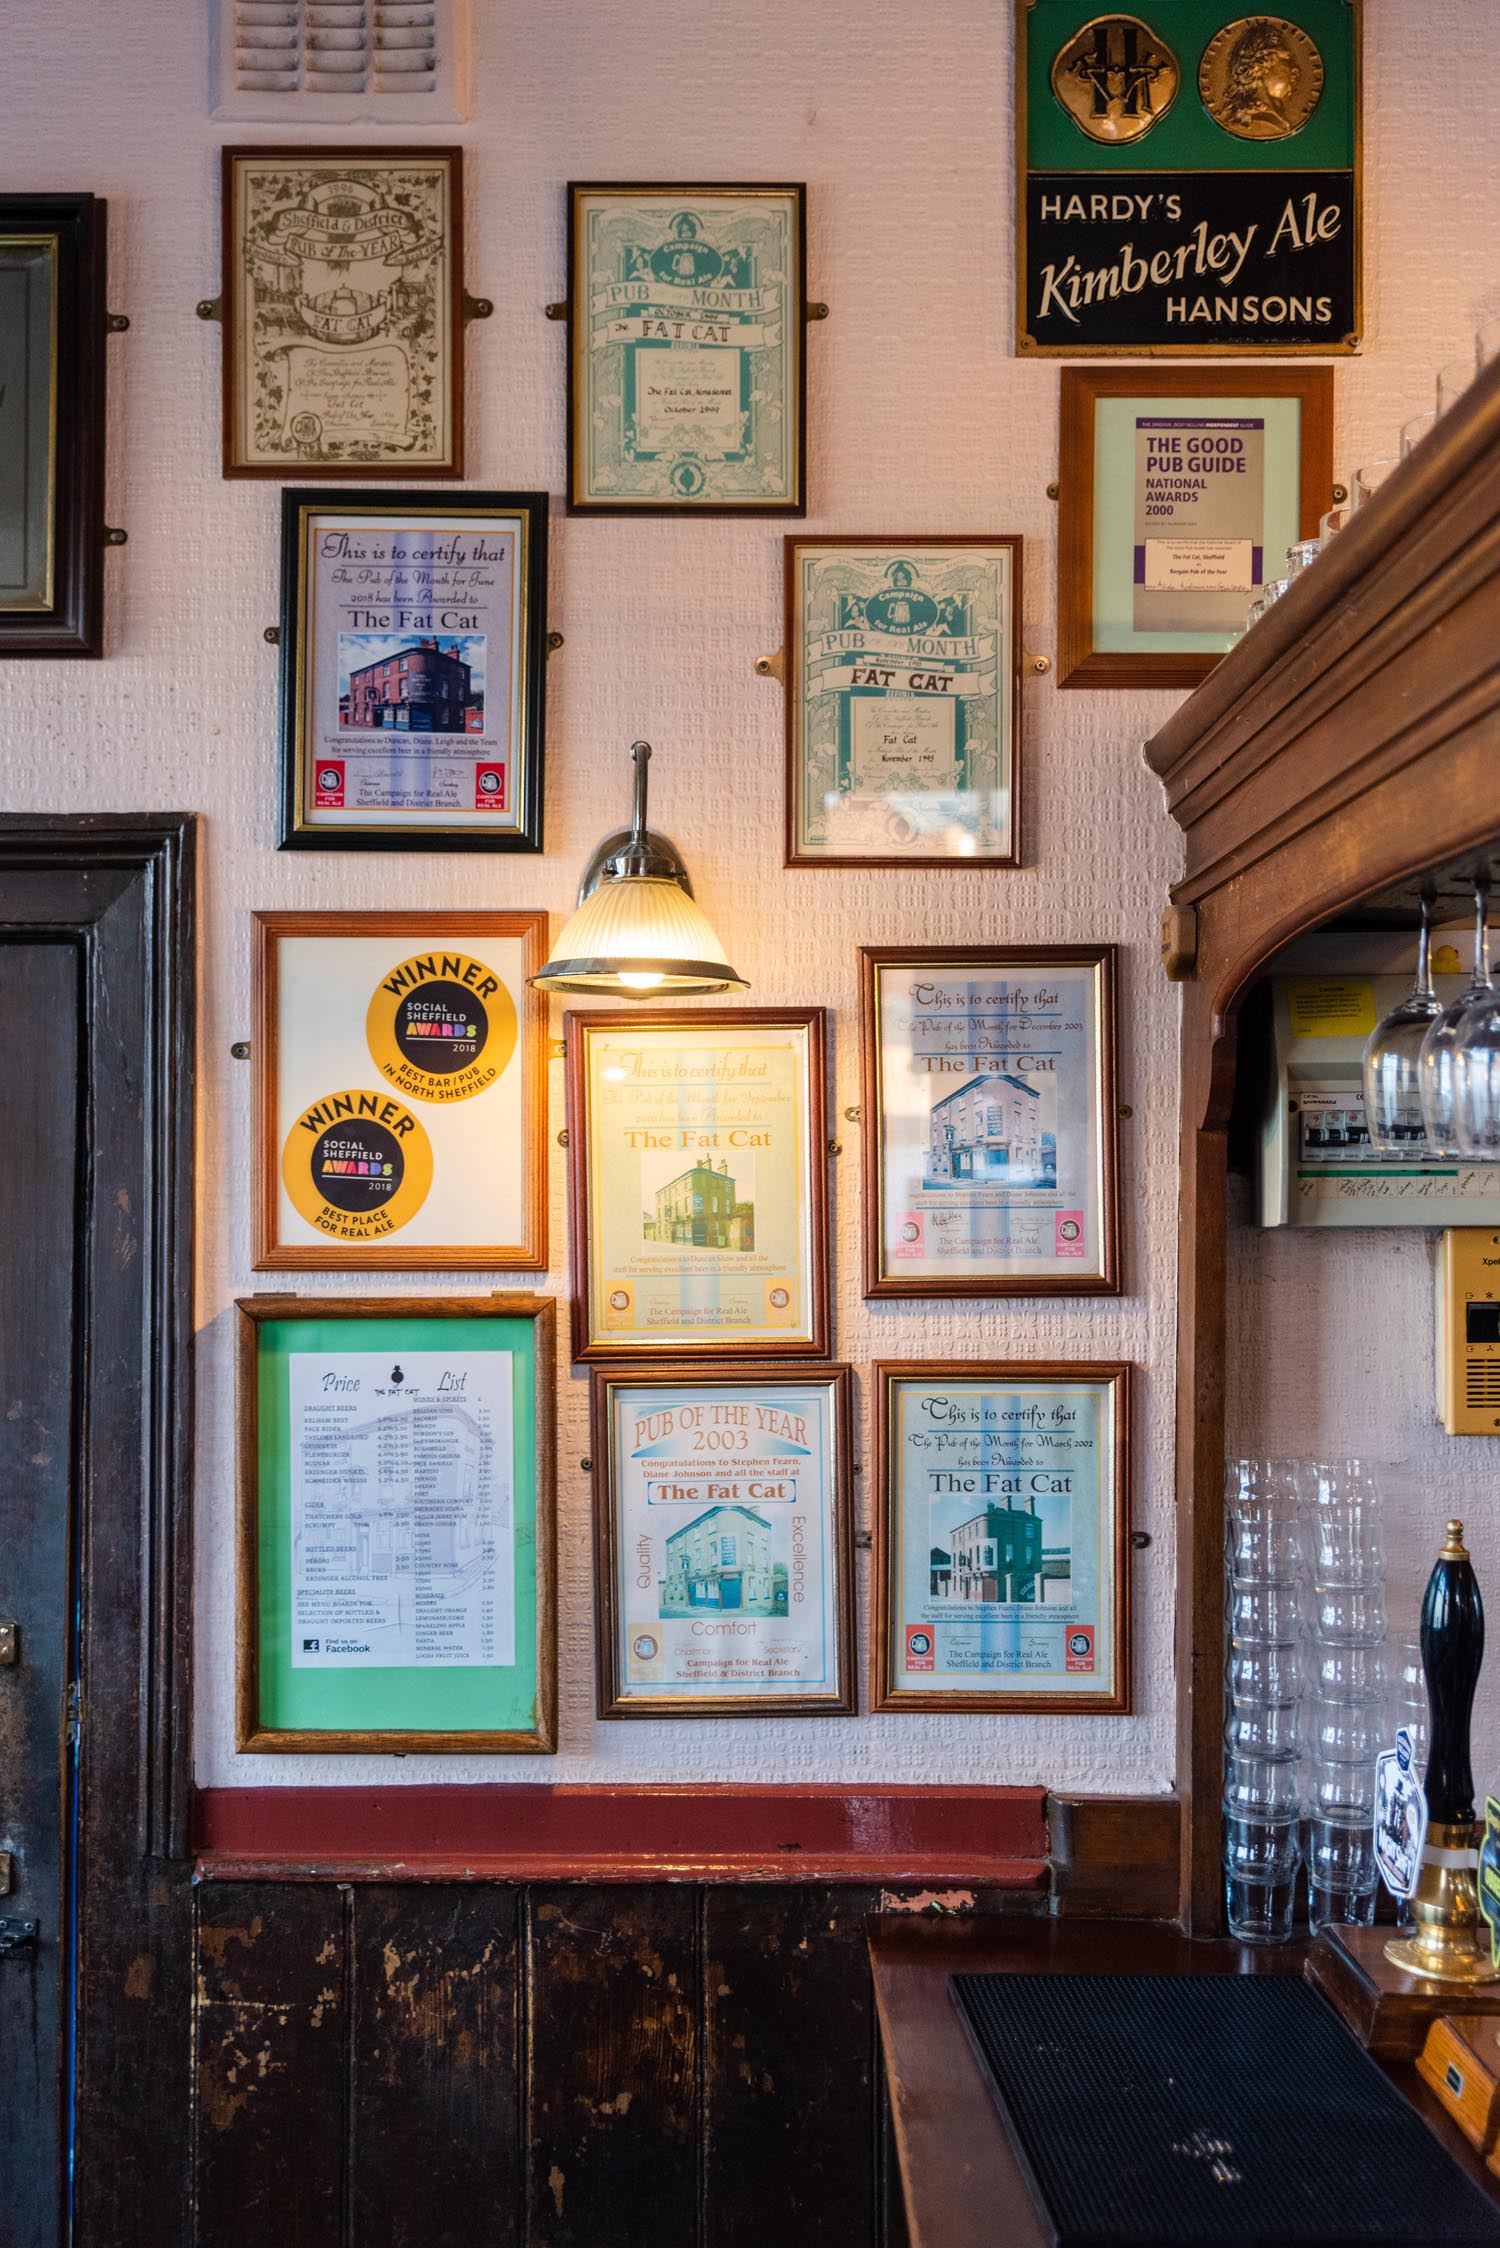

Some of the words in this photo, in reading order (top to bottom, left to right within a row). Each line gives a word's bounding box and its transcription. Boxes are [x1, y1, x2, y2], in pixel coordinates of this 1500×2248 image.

[1040, 194, 1182, 220] HARDY'S
[284, 213, 338, 230] Sheffield
[355, 214, 403, 229] District
[291, 237, 316, 252] PUB
[360, 236, 398, 257] YEAR
[1036, 221, 1258, 324] Kimberley
[1266, 192, 1342, 255] Ale
[610, 286, 649, 301] PUB
[692, 290, 760, 308] MONTH
[1166, 296, 1332, 322] HANSONS
[313, 314, 342, 332] FAT
[347, 314, 372, 330] CAT
[643, 320, 685, 339] FAT
[692, 326, 731, 342] CAT
[664, 387, 677, 396] Fat
[1147, 438, 1181, 453] THE
[1187, 438, 1243, 454] GOOD
[1147, 457, 1183, 473] PUB
[1188, 457, 1246, 473] GUIDE
[1146, 479, 1207, 489] NATIONAL
[1146, 492, 1199, 502] AWARDS
[1146, 505, 1173, 515] 2000
[321, 533, 366, 560] This
[374, 543, 385, 560] is
[391, 546, 406, 560] to
[412, 536, 466, 565] certify
[472, 539, 505, 561] that
[331, 569, 352, 584] The
[357, 570, 381, 585] Pub
[384, 571, 395, 585] of
[395, 574, 408, 585] the
[414, 570, 450, 586] Month
[451, 571, 465, 587] for
[469, 571, 495, 586] June
[351, 593, 372, 603] 2018
[376, 592, 391, 603] has
[394, 592, 414, 603] been
[418, 589, 466, 604] Awarded
[470, 593, 478, 604] to
[879, 591, 924, 602] Campaign
[348, 610, 390, 628] The
[400, 611, 433, 628] Fat
[441, 612, 479, 629] Cat
[874, 620, 888, 631] for
[890, 624, 910, 633] Real
[913, 621, 928, 632] Ale
[825, 633, 865, 650] PUB
[907, 638, 976, 656] MONTH
[851, 668, 896, 687] FAT
[909, 674, 953, 692] CAT
[883, 735, 897, 744] Fat
[903, 735, 917, 744] Cat
[383, 956, 498, 1000] WINNER
[909, 983, 952, 1011] This
[956, 993, 965, 1006] is
[970, 994, 981, 1005] to
[986, 988, 1028, 1013] certify
[1034, 988, 1059, 1010] that
[407, 1002, 448, 1012] SOCIAL
[407, 1012, 467, 1022] SHEFFIELD
[406, 1022, 477, 1038] AWARDS
[453, 1044, 476, 1052] 2018
[921, 1056, 964, 1072] The
[974, 1056, 1008, 1071] Fat
[1016, 1055, 1056, 1071] Cat
[384, 1063, 396, 1076] IN
[396, 1077, 434, 1098] NORTH
[439, 1067, 496, 1099] SHEFFIELD
[400, 1064, 425, 1083] BEST
[300, 1094, 415, 1138] WINNER
[324, 1140, 364, 1150] SOCIAL
[624, 1131, 672, 1148] The
[681, 1130, 720, 1148] Fat
[728, 1130, 772, 1147] Cat
[323, 1150, 383, 1160] SHEFFIELD
[322, 1159, 393, 1176] AWARDS
[369, 1183, 392, 1191] 2018
[322, 1207, 348, 1223] BEST
[352, 1210, 388, 1225] PLACE
[315, 1216, 338, 1232] FOR
[341, 1227, 370, 1237] REAL
[374, 1220, 395, 1235] ALE
[322, 1372, 361, 1392] Price
[437, 1371, 468, 1392] List
[922, 1397, 966, 1425] This
[971, 1407, 980, 1421] is
[984, 1409, 997, 1420] to
[1001, 1404, 1045, 1429] certify
[1050, 1405, 1076, 1426] that
[634, 1411, 674, 1448] PUB
[679, 1406, 704, 1430] OF
[710, 1406, 750, 1425] THE
[756, 1407, 808, 1446] YEAR
[693, 1430, 748, 1450] 2003
[641, 1459, 716, 1468] Congratulations
[718, 1458, 729, 1466] to
[732, 1457, 770, 1467] Stephen
[643, 1470, 669, 1478] Diane
[672, 1470, 712, 1478] Johnson
[714, 1469, 733, 1477] and
[734, 1469, 746, 1477] all
[767, 1468, 788, 1476] staff
[790, 1468, 800, 1476] at
[657, 1485, 698, 1500] The
[707, 1484, 740, 1499] Fat
[748, 1483, 786, 1498] Cat
[930, 1474, 976, 1493] The
[984, 1474, 1022, 1493] Fat
[1030, 1474, 1072, 1492] Cat
[636, 1534, 654, 1589] Quality
[792, 1516, 806, 1603] Excellence
[691, 1621, 758, 1637] Comfort
[326, 1645, 370, 1653] Facebook
[687, 1659, 733, 1669] Campaign
[735, 1658, 749, 1666] for
[751, 1658, 772, 1666] Real
[774, 1658, 789, 1666] Ale
[676, 1670, 718, 1679] Sheffield
[720, 1670, 728, 1678] &
[730, 1669, 765, 1678] District
[768, 1669, 800, 1677] Branch
